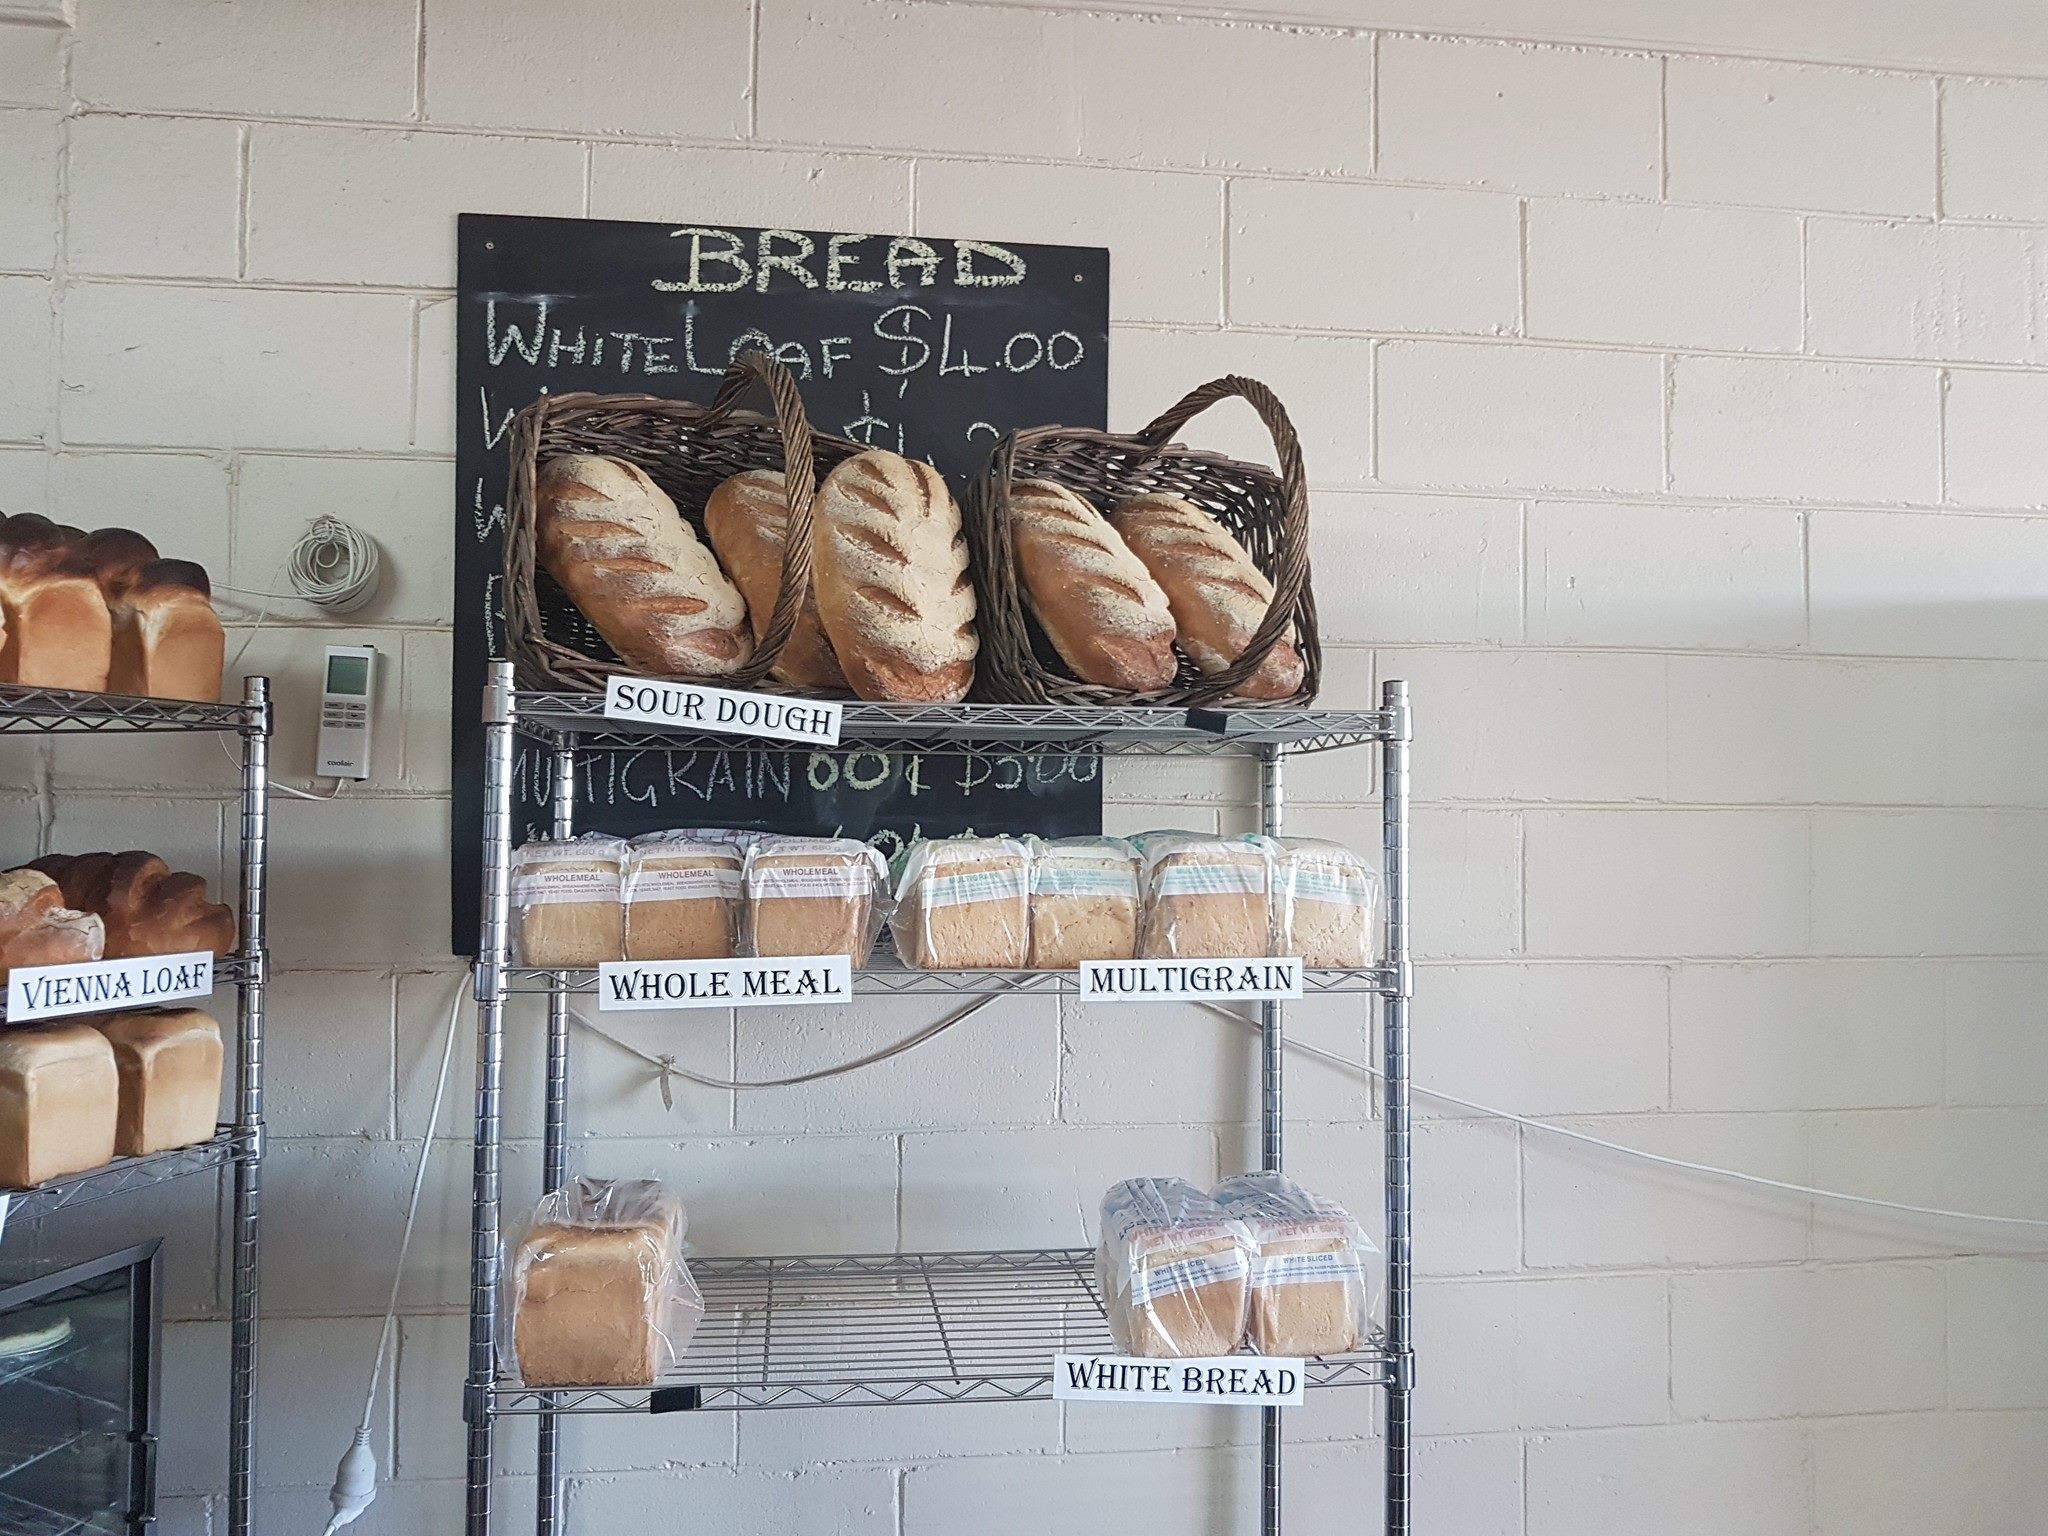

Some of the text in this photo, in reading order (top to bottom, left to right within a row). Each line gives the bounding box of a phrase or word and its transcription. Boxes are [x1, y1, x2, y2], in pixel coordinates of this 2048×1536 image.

[651, 227, 1027, 293] BREAD
[614, 684, 832, 737] SOUR DOUGH
[544, 873, 601, 882] WHOLEMEAL
[658, 869, 715, 879] WHOLEMEAL
[782, 867, 839, 876] WHOLEMEAL
[22, 962, 207, 1010] VIENNA LOAF
[608, 968, 843, 1001] WHOLE MEAL
[1090, 965, 1294, 994] MULTIGRAIN
[1283, 1254, 1333, 1264] WHITE SLICED
[1066, 1357, 1296, 1396] WHITE BREAD
